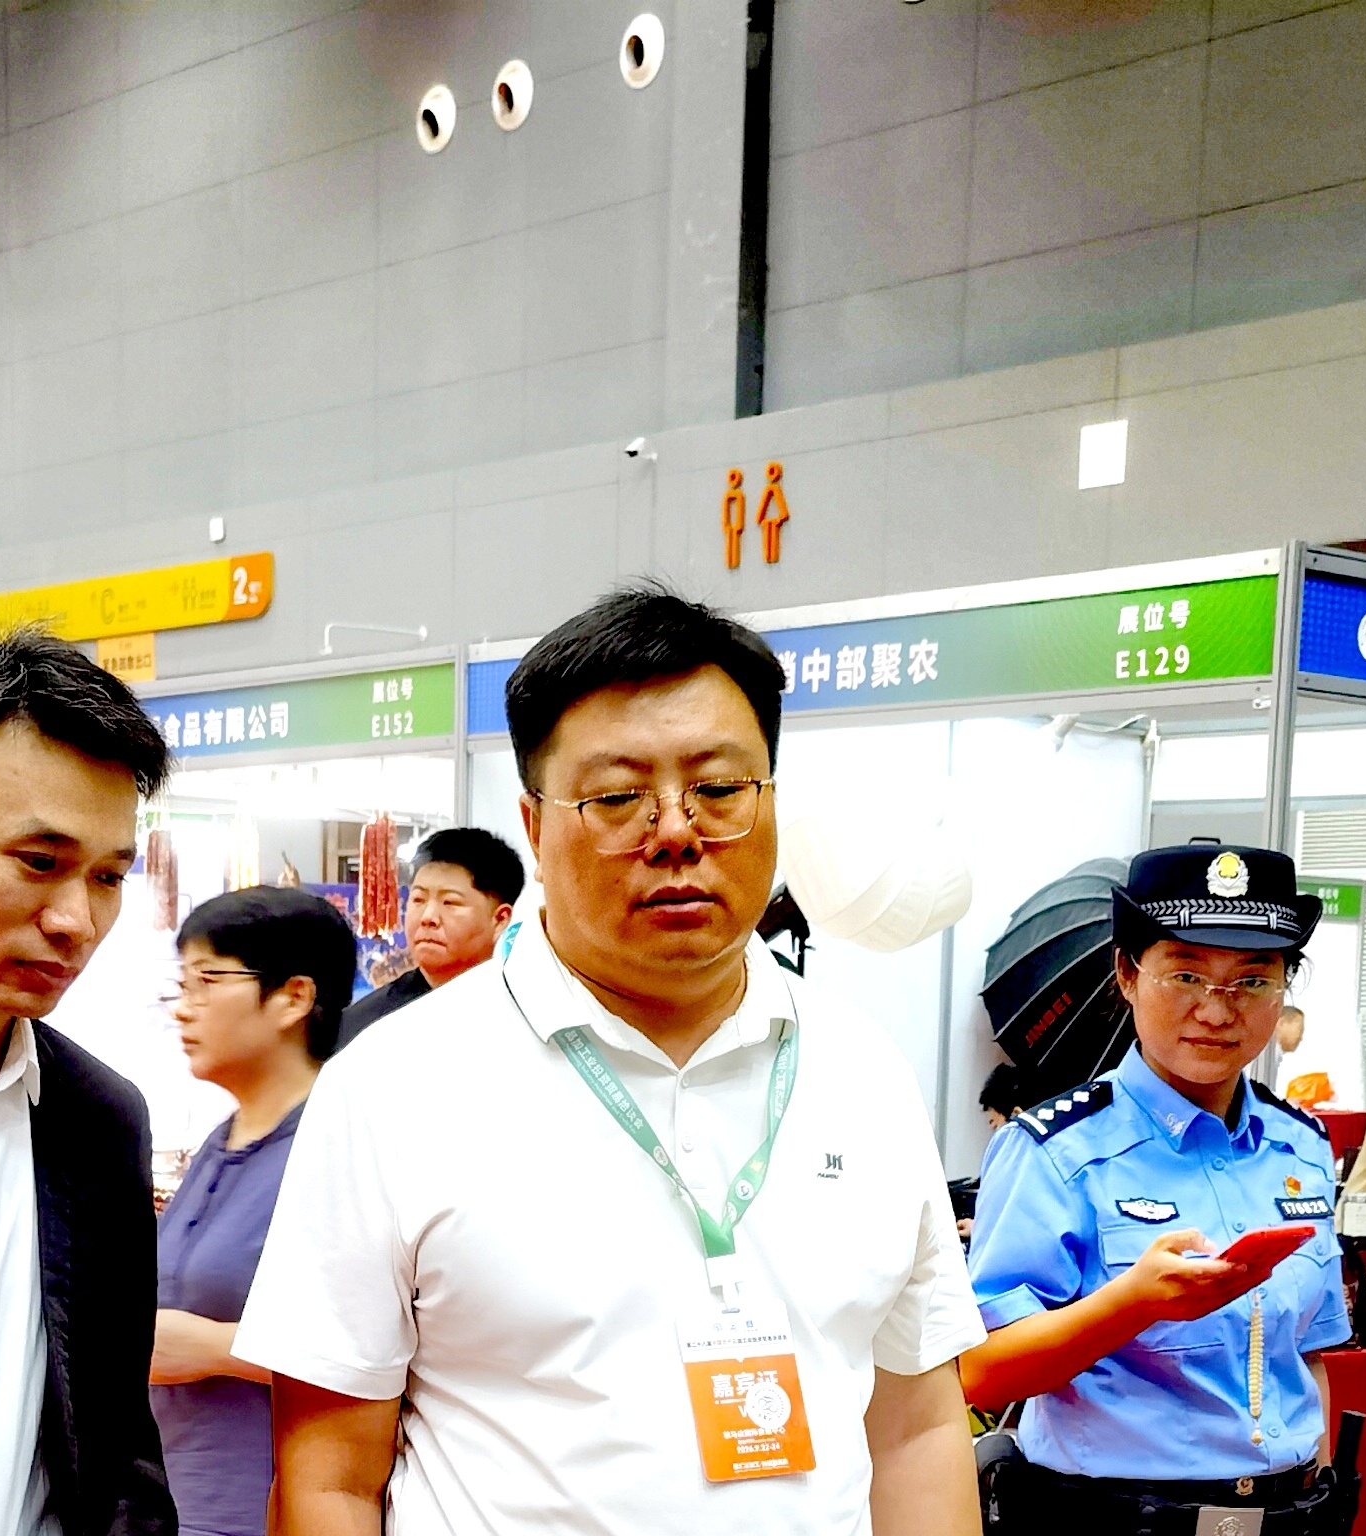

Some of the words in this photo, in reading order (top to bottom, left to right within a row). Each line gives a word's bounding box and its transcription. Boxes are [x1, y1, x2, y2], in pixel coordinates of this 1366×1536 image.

[1117, 599, 1191, 634] 展位号
[1115, 644, 1191, 680] E129
[152, 701, 289, 748] 食品有限公司
[372, 712, 414, 737] E152
